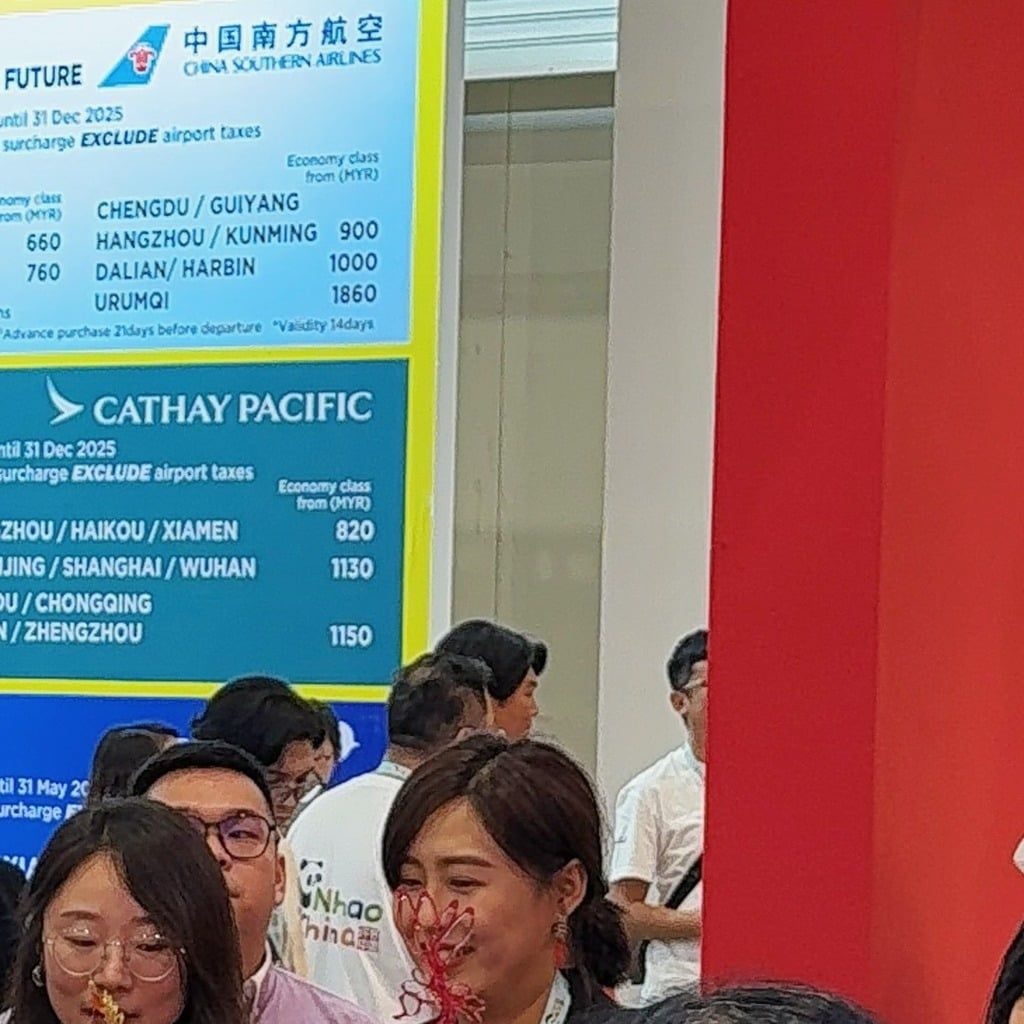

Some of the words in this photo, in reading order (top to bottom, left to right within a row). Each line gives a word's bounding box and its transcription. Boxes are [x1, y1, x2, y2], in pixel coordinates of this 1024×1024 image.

[184, 13, 383, 54] 中国南方航空
[183, 58, 227, 76] CHINA
[233, 52, 311, 74] SOUTHERN
[316, 48, 381, 67] AIRLINES
[5, 63, 83, 89] FUTURE
[33, 111, 47, 127] 31
[52, 108, 81, 125] Dec
[85, 106, 124, 123] 2025
[3, 133, 75, 152] surcharge
[81, 127, 158, 148] EXCLUDE
[162, 125, 216, 144] airport
[220, 122, 261, 140] taxes
[287, 154, 345, 168] Economy
[349, 151, 379, 164] class
[305, 170, 335, 183] from
[339, 168, 379, 183] (MYR)
[34, 191, 62, 204] class
[97, 198, 189, 220] CHENGDU
[210, 192, 299, 215] GUIYANG
[26, 208, 62, 223] (MYR)
[96, 228, 205, 251] HANGZHOU
[226, 222, 317, 246] KUNMING
[339, 220, 378, 241] 900
[27, 232, 61, 252] 660
[27, 263, 61, 282] 760
[182, 257, 256, 278] HARBIN
[330, 252, 378, 272] 1000
[94, 290, 169, 312] URUMQI
[332, 283, 377, 304] 1860
[57, 325, 110, 341] purchase
[157, 322, 197, 336] before
[200, 320, 262, 337] departure
[93, 393, 231, 425] CATHAY
[237, 391, 373, 423] PACIFIC
[24, 441, 39, 458] 31
[43, 441, 73, 458] Dec
[76, 440, 117, 458] 2025
[71, 464, 153, 482] EXCLUDE
[153, 463, 208, 484] airport
[212, 463, 254, 482] taxes
[278, 479, 336, 495] Economy
[339, 478, 372, 493] class
[296, 496, 327, 510] from
[329, 495, 372, 512] (MYR)
[70, 520, 145, 541] HAIKOU
[162, 520, 239, 541] XIAMEN
[336, 520, 374, 541] 820
[62, 557, 162, 578] SHANGHAI
[179, 557, 256, 579] WUHAN
[331, 558, 374, 579] 1130
[35, 592, 152, 614] CHONGQING
[24, 621, 142, 643] ZHENGZHOU
[329, 625, 373, 647] 1150
[18, 778, 33, 794] 31
[37, 779, 67, 799] May
